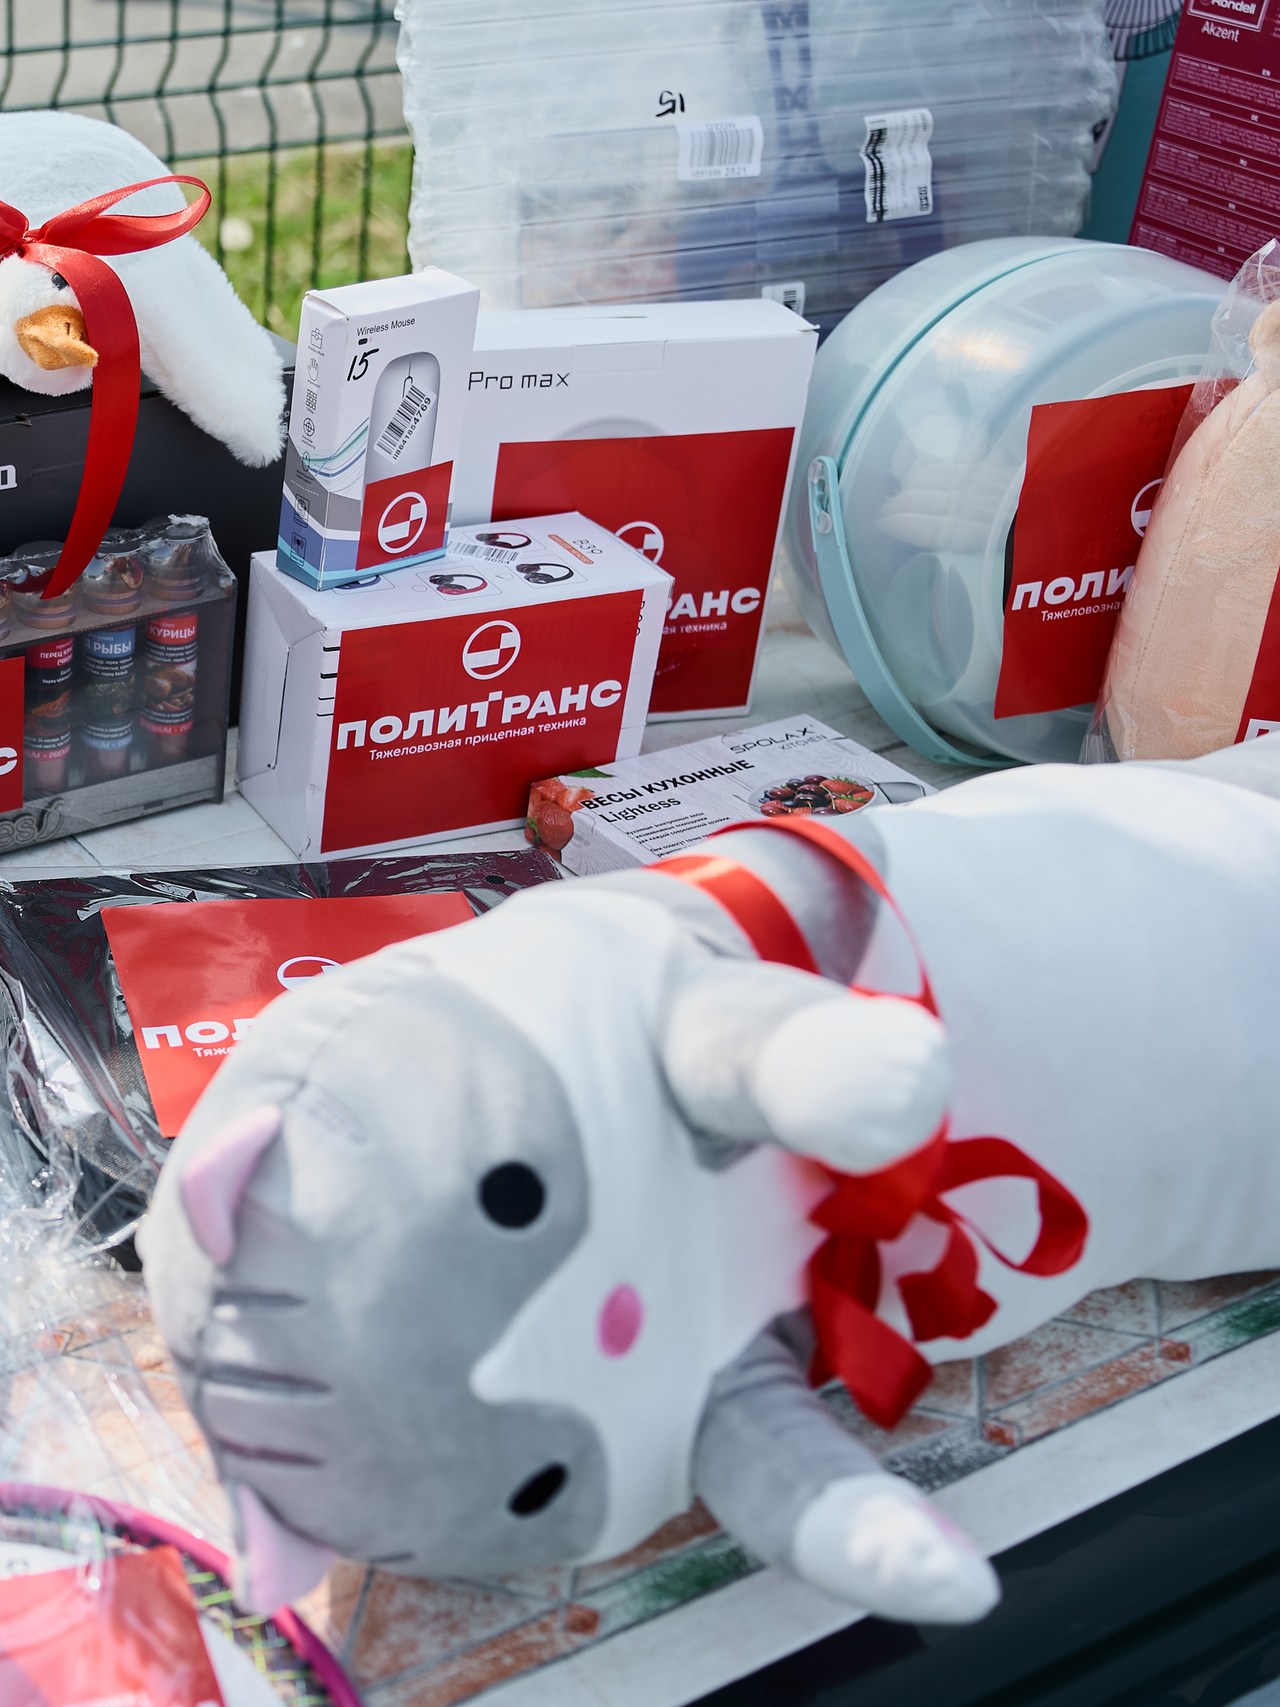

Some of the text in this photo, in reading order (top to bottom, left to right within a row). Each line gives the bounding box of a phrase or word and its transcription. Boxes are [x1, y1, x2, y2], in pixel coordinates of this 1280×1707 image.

[1201, 20, 1240, 43] Akzent
[356, 317, 416, 337] Wireless Mouse
[346, 348, 380, 382] 15
[468, 371, 570, 391] Pro max
[1011, 565, 1136, 611] ПОЛИ
[1041, 600, 1124, 622] Тяжеловозна
[149, 626, 196, 640] КУРИЦЫ
[680, 621, 728, 634] техника
[93, 641, 132, 655] РЫБЫ
[336, 679, 622, 750] ПОЛИТРАНС
[369, 716, 587, 761] Тяжеловозная прицепная техника
[730, 727, 814, 754] SPOLAX
[580, 759, 755, 812] ВЕСЫ КУХОННЫЕ
[599, 797, 682, 824] Lightess
